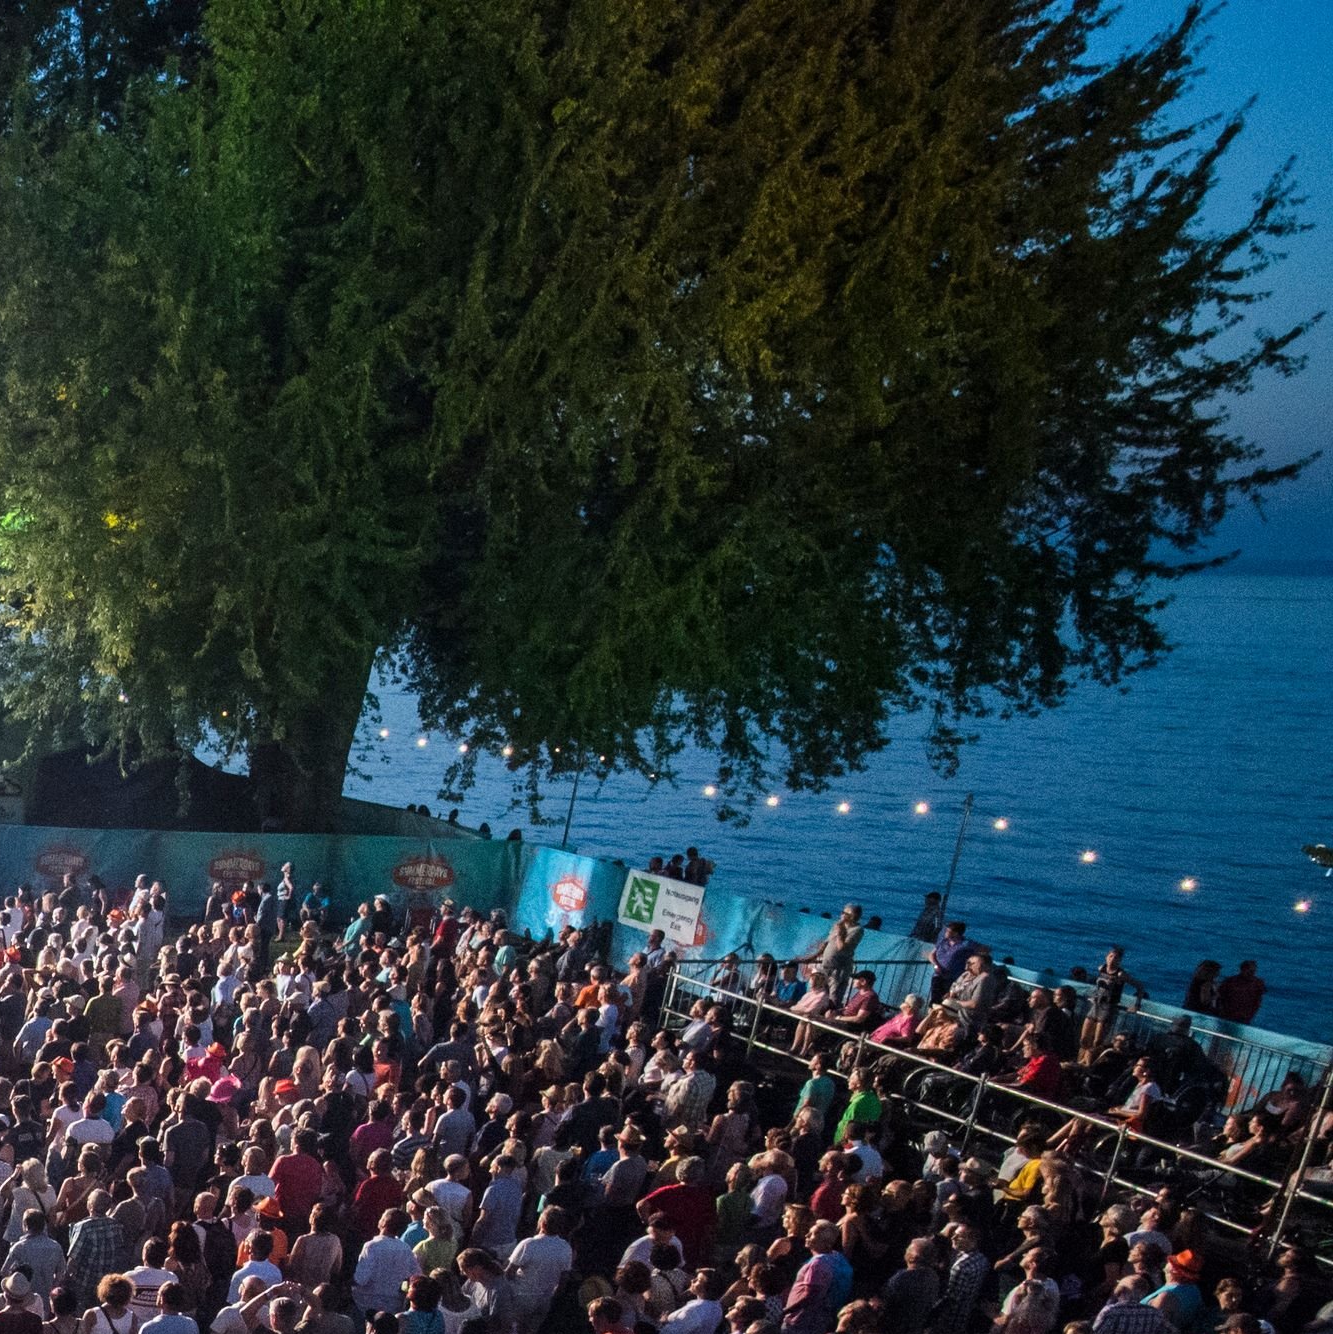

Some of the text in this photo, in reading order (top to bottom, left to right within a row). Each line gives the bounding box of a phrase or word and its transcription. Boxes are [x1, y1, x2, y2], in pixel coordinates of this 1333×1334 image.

[665, 888, 700, 906] Notausgang
[662, 908, 694, 926] Emergency
[669, 921, 681, 932] Exit
